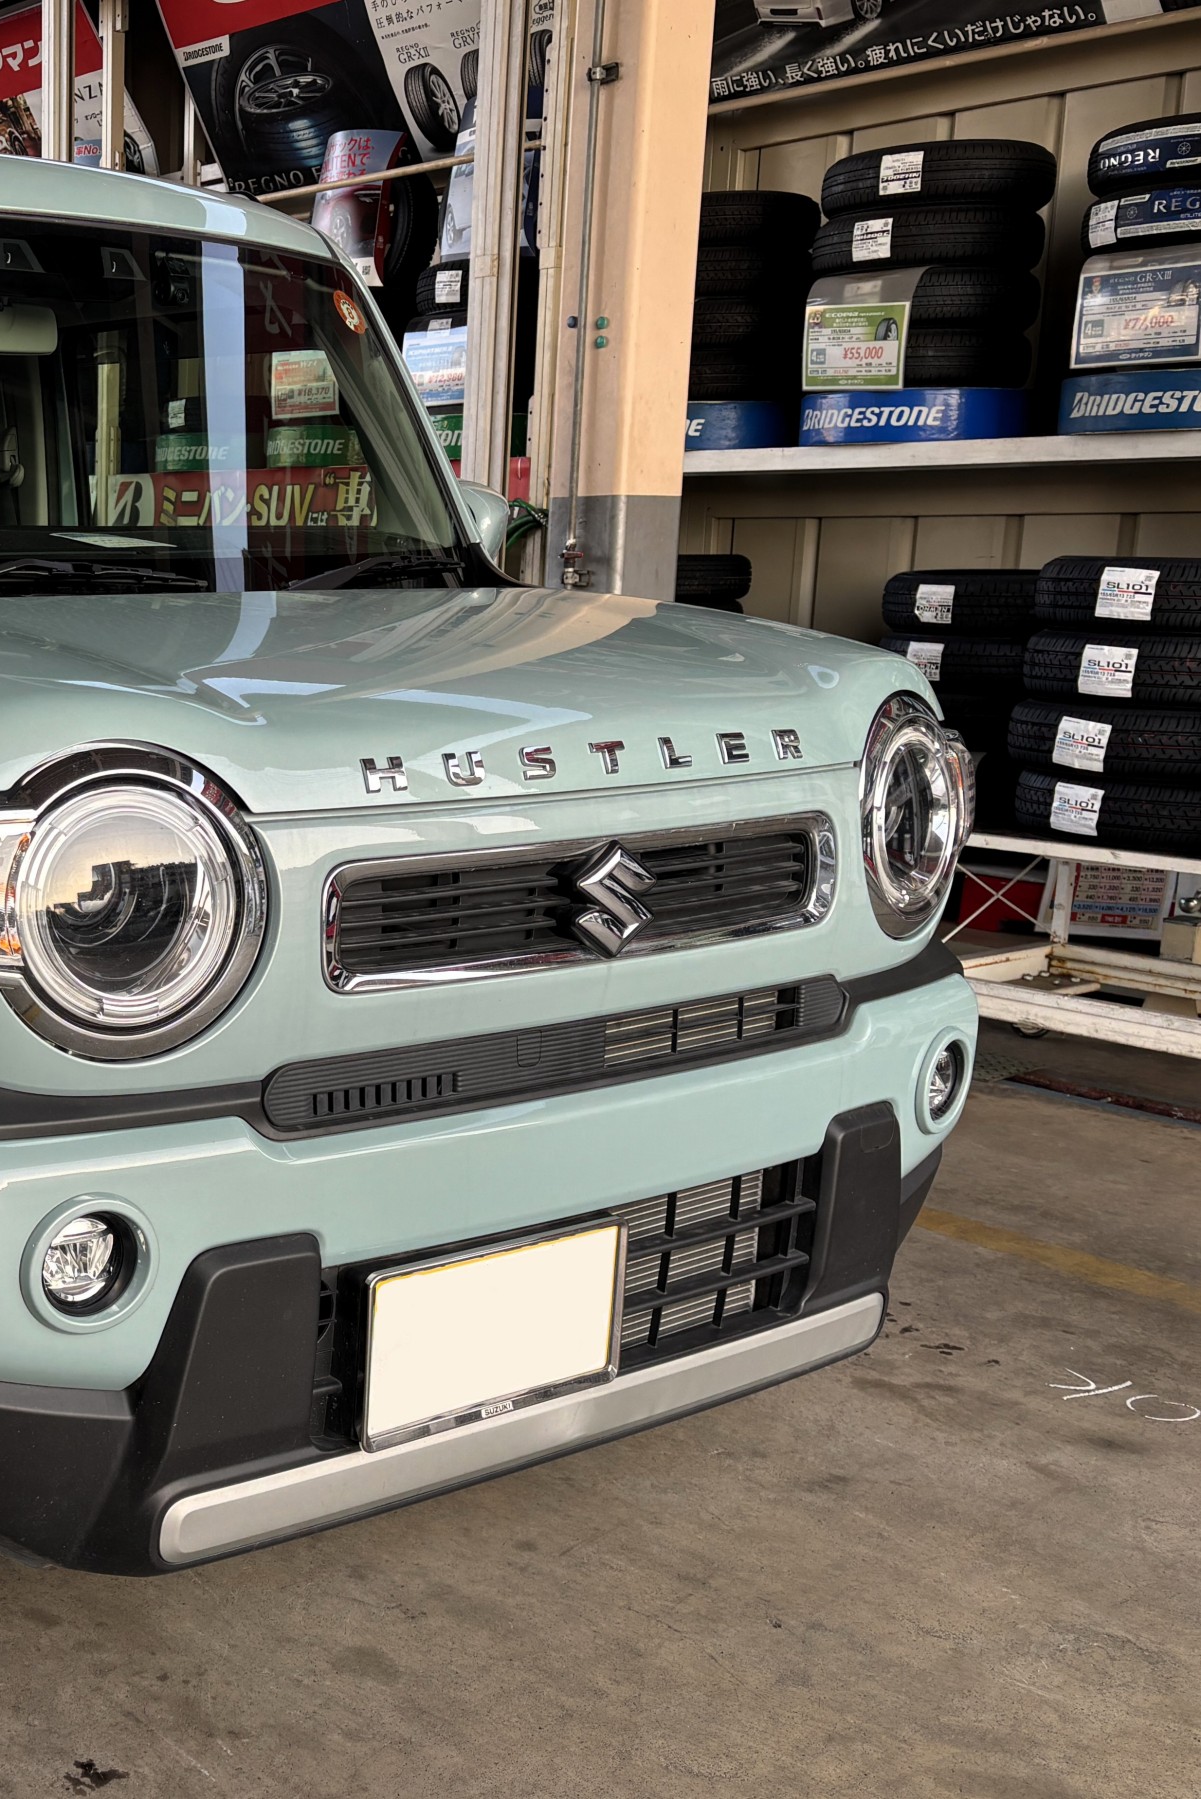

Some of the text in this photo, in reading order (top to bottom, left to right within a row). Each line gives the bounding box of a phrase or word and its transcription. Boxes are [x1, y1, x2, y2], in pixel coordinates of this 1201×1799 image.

[450, 26, 476, 39] REGNO
[182, 42, 224, 61] BRIDGESTONE
[1100, 148, 1160, 170] REGNO
[842, 346, 884, 361] ¥55,000
[803, 406, 945, 431] BRIDGESTONE
[1106, 581, 1150, 592] SL101
[1087, 659, 1129, 670] SL101
[1062, 731, 1102, 745] SL101
[359, 728, 804, 794] HUSTLER
[1058, 797, 1095, 810] SL101
[484, 1402, 512, 1417] SUZUKI
